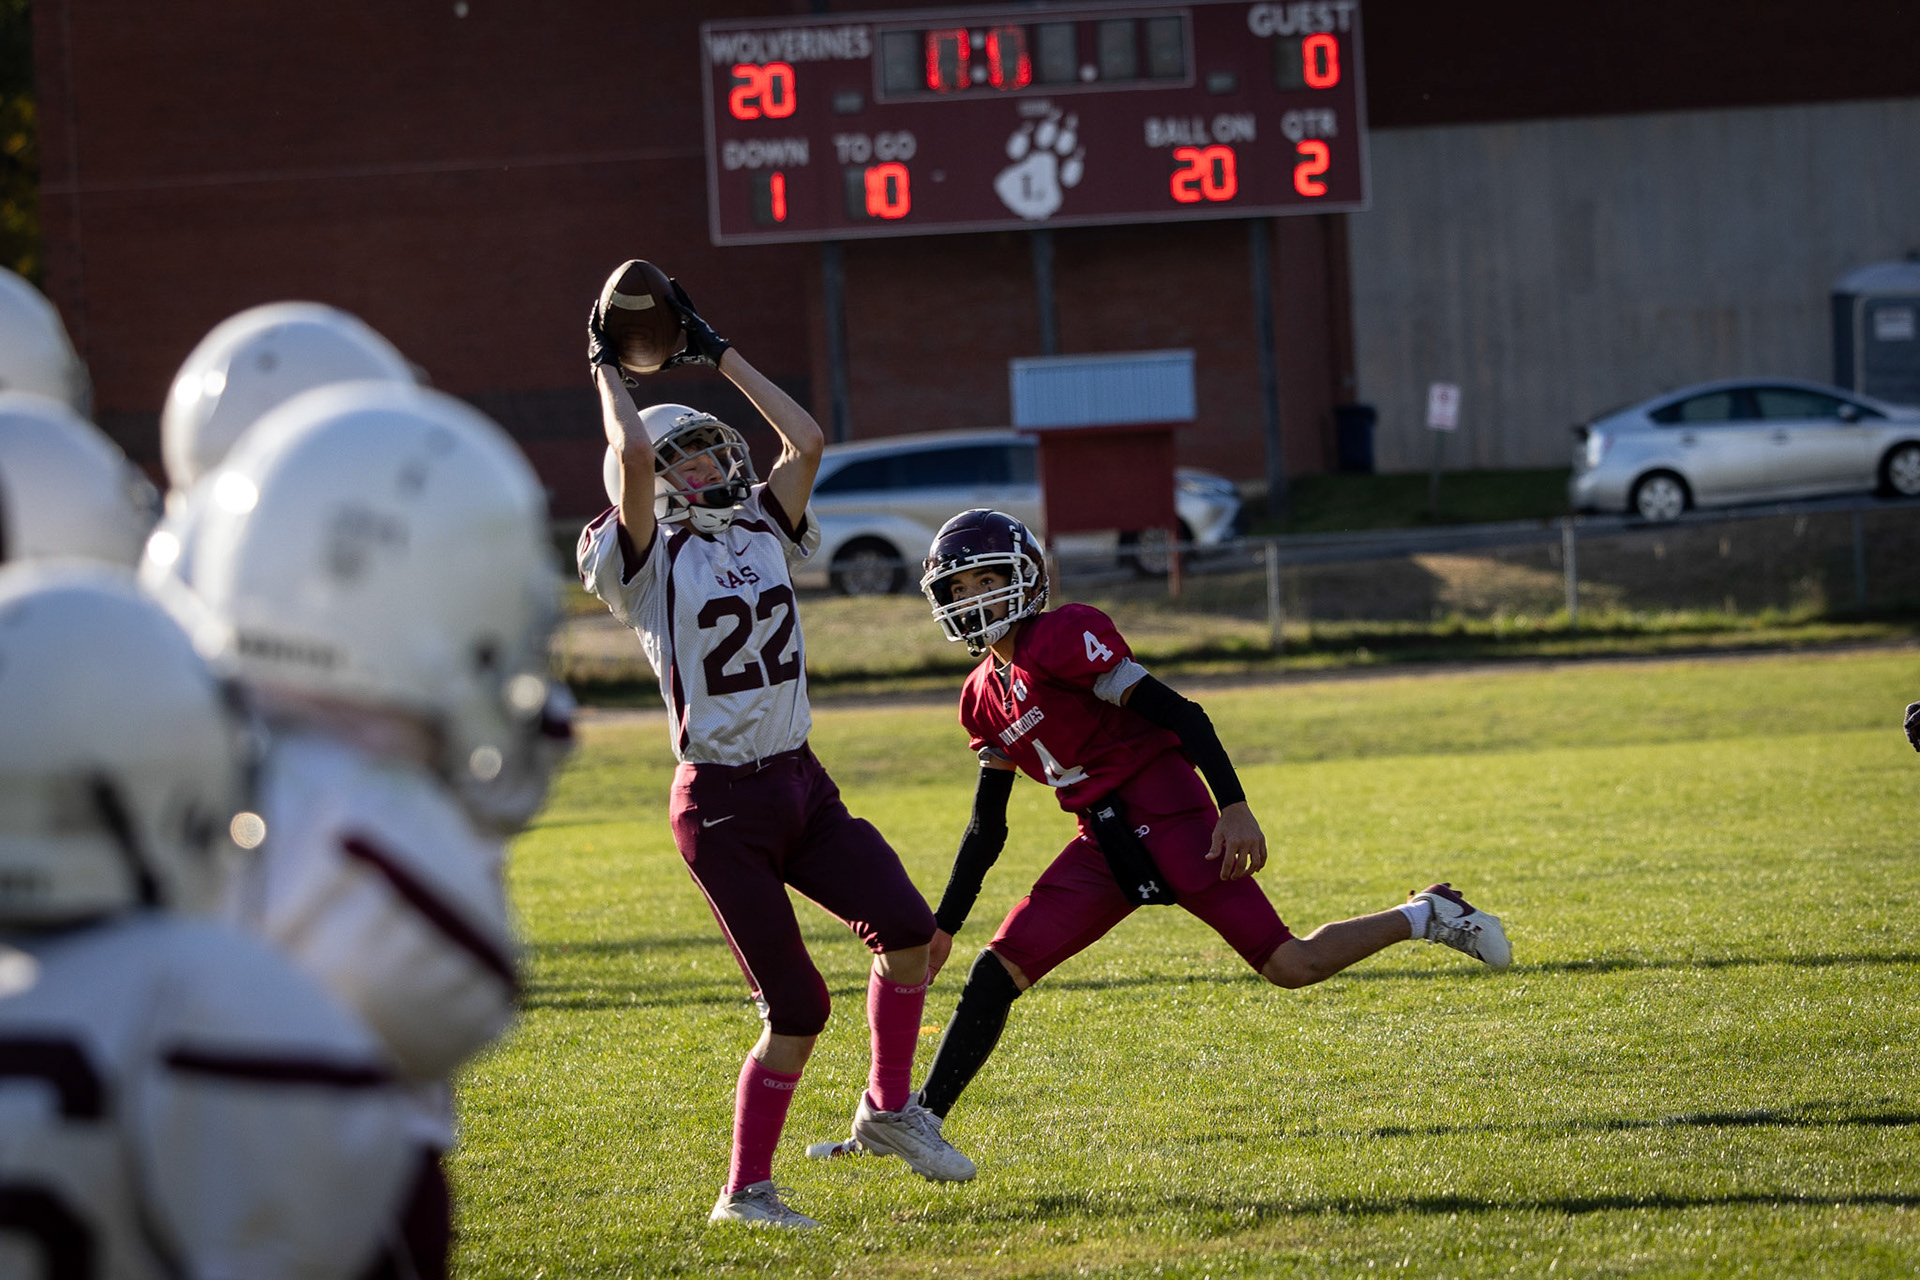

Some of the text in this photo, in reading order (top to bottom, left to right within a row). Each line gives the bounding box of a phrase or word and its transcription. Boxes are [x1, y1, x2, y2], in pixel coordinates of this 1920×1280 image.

[1248, 1, 1353, 37] GUEST
[708, 26, 871, 64] WOLVERINES
[1302, 32, 1340, 89] 0
[729, 61, 797, 120] 20
[832, 130, 917, 164] TO GO
[1145, 113, 1256, 147] BALL ON
[1281, 108, 1338, 142] QTR
[722, 138, 810, 170] DOWN
[1170, 145, 1238, 203] 20
[1293, 139, 1330, 197] 2
[770, 171, 787, 222] 1
[864, 161, 911, 219] 10
[697, 584, 800, 696] 22
[1082, 630, 1114, 663] 4
